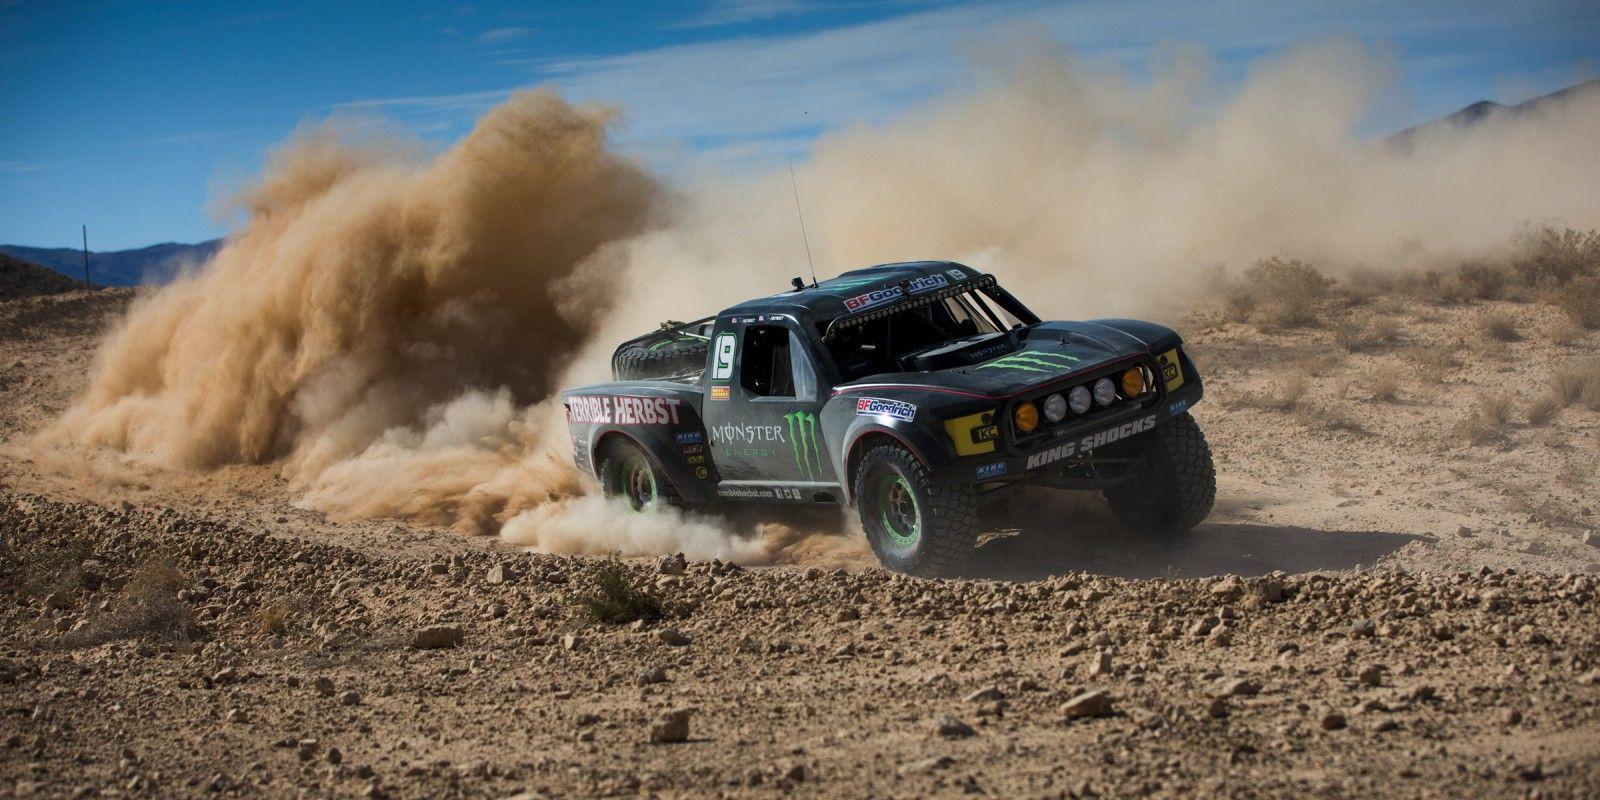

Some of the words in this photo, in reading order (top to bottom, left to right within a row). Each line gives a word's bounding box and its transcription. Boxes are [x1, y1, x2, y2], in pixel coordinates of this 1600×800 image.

[712, 333, 736, 380] 19
[568, 396, 611, 423] TERRIBLE
[613, 396, 680, 425] HERBST
[857, 399, 915, 418] BFGoodrich
[978, 425, 998, 440] KC
[1026, 441, 1076, 470] KING
[1080, 414, 1157, 452] SHOCKS
[724, 448, 776, 457] ENERGY
